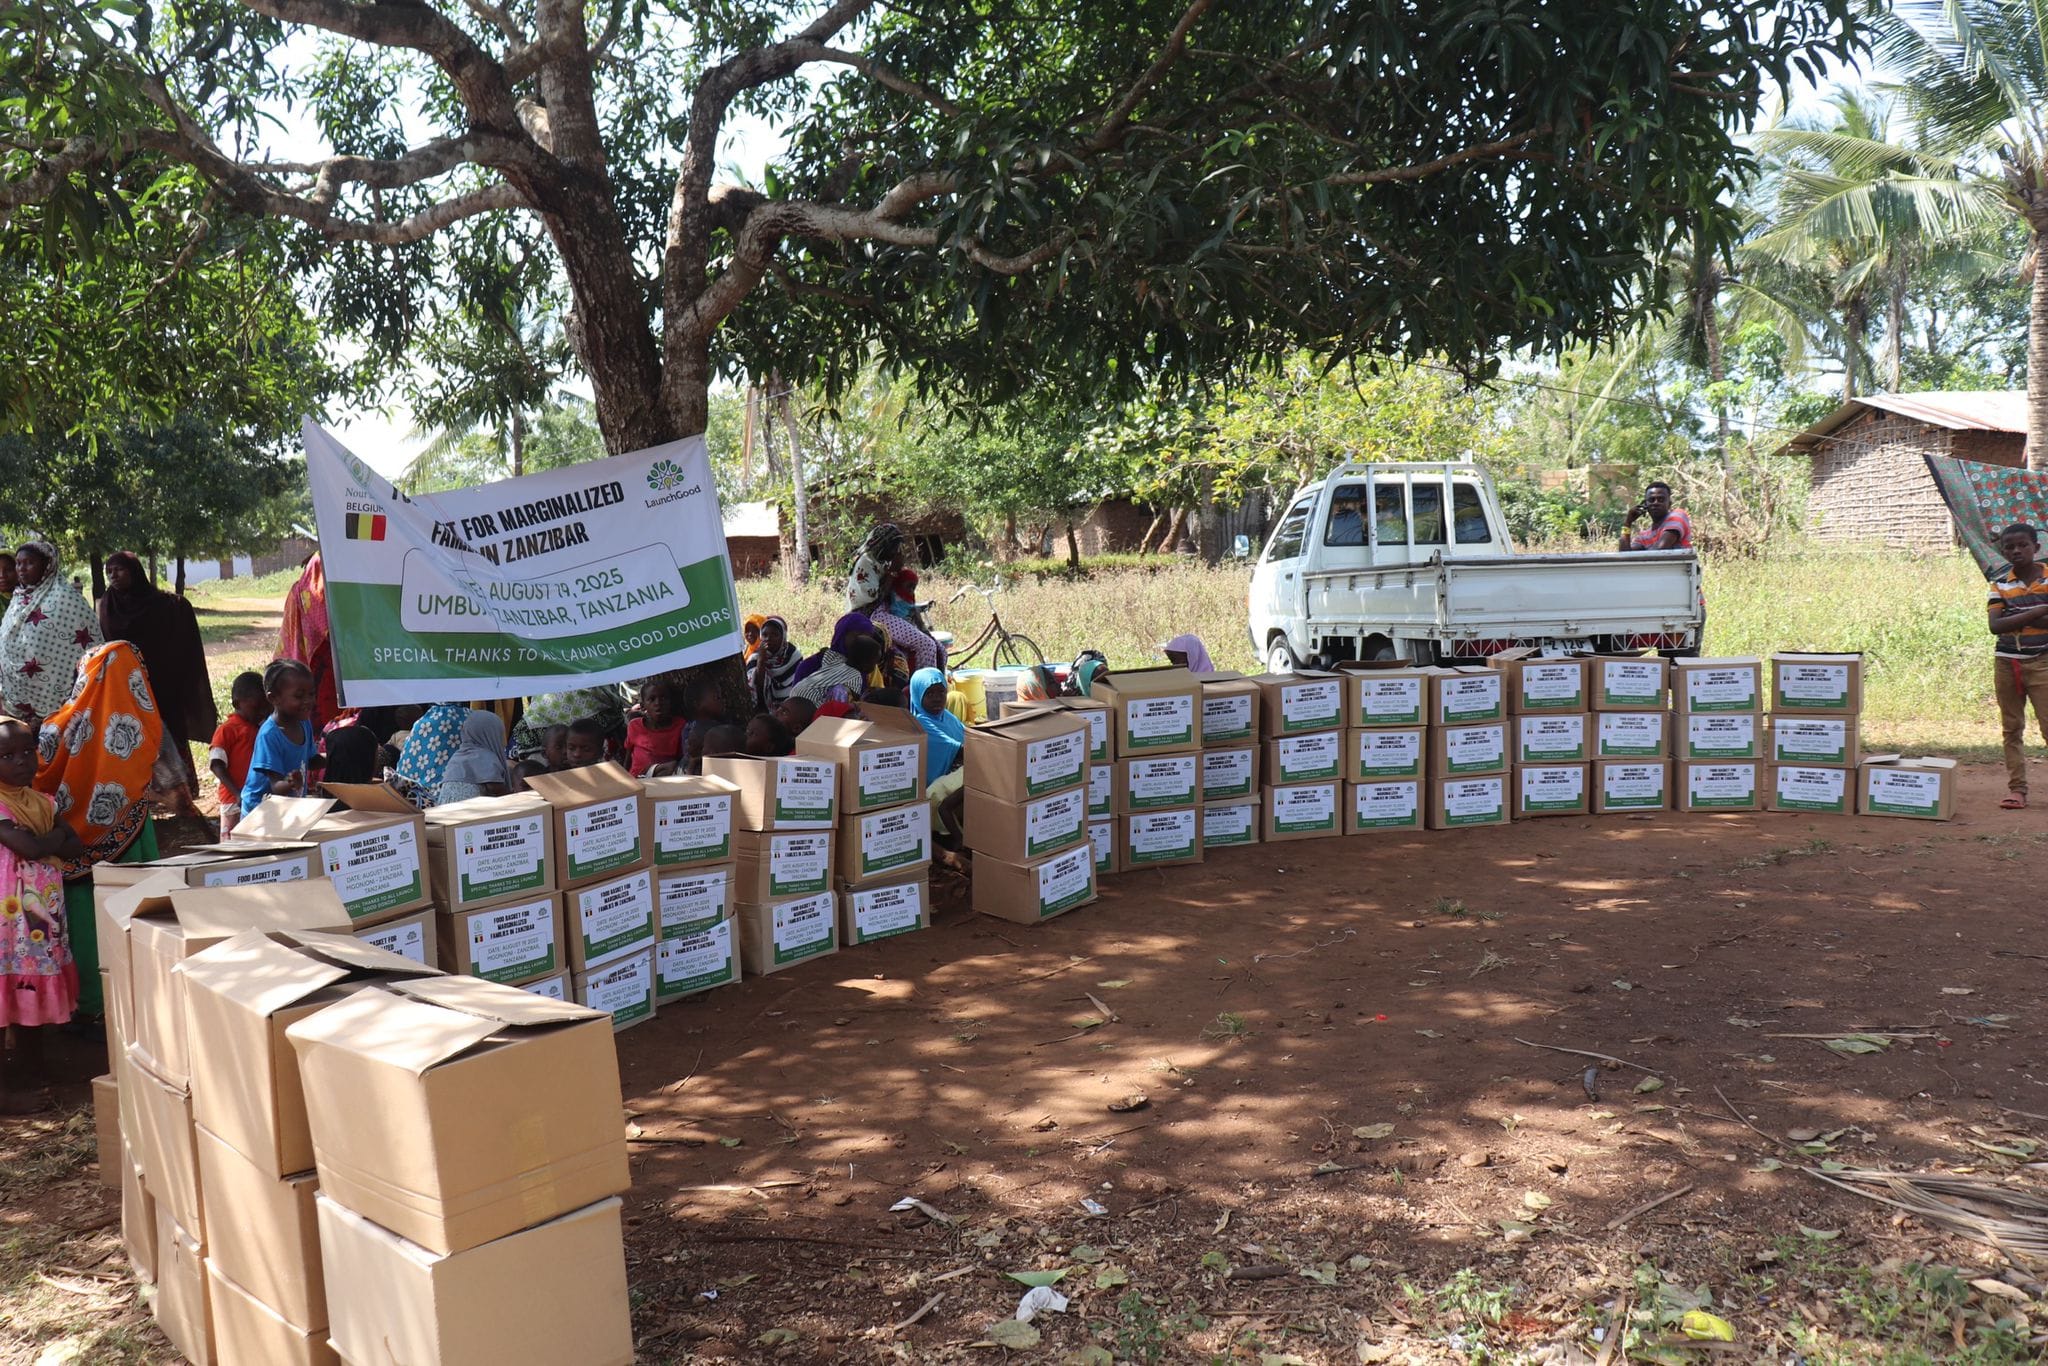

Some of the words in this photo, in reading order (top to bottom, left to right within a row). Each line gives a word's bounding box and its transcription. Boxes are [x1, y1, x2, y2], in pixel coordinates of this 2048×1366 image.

[644, 485, 702, 508] LaunchGood
[461, 514, 499, 541] FOR
[498, 481, 624, 532] MARGINALIZED
[504, 522, 590, 563] ZANZIBAR
[490, 582, 550, 600] AUGUST
[576, 568, 624, 592] 2025
[492, 606, 576, 625] ZANZIBAR,
[576, 581, 674, 620] TANZANIA
[374, 646, 438, 662] SPECIAL
[445, 648, 510, 662] THANKS
[518, 648, 538, 662] TO
[561, 643, 617, 662] LAUNCH
[618, 630, 664, 652] GOOD
[667, 608, 731, 638] DONORS
[350, 841, 362, 850] FOOD
[363, 837, 380, 846] BASKET
[481, 843, 499, 851] FAMILIES
[506, 838, 525, 847] ZANZIBAR
[347, 856, 368, 867] FAMILIES
[375, 849, 397, 860] ZANZIBAR
[238, 874, 250, 883] FOOD
[252, 871, 270, 881] BASKET
[505, 912, 521, 921] BASKET
[490, 930, 509, 939] FAMILIES
[515, 924, 535, 934] ZANZIBAR
